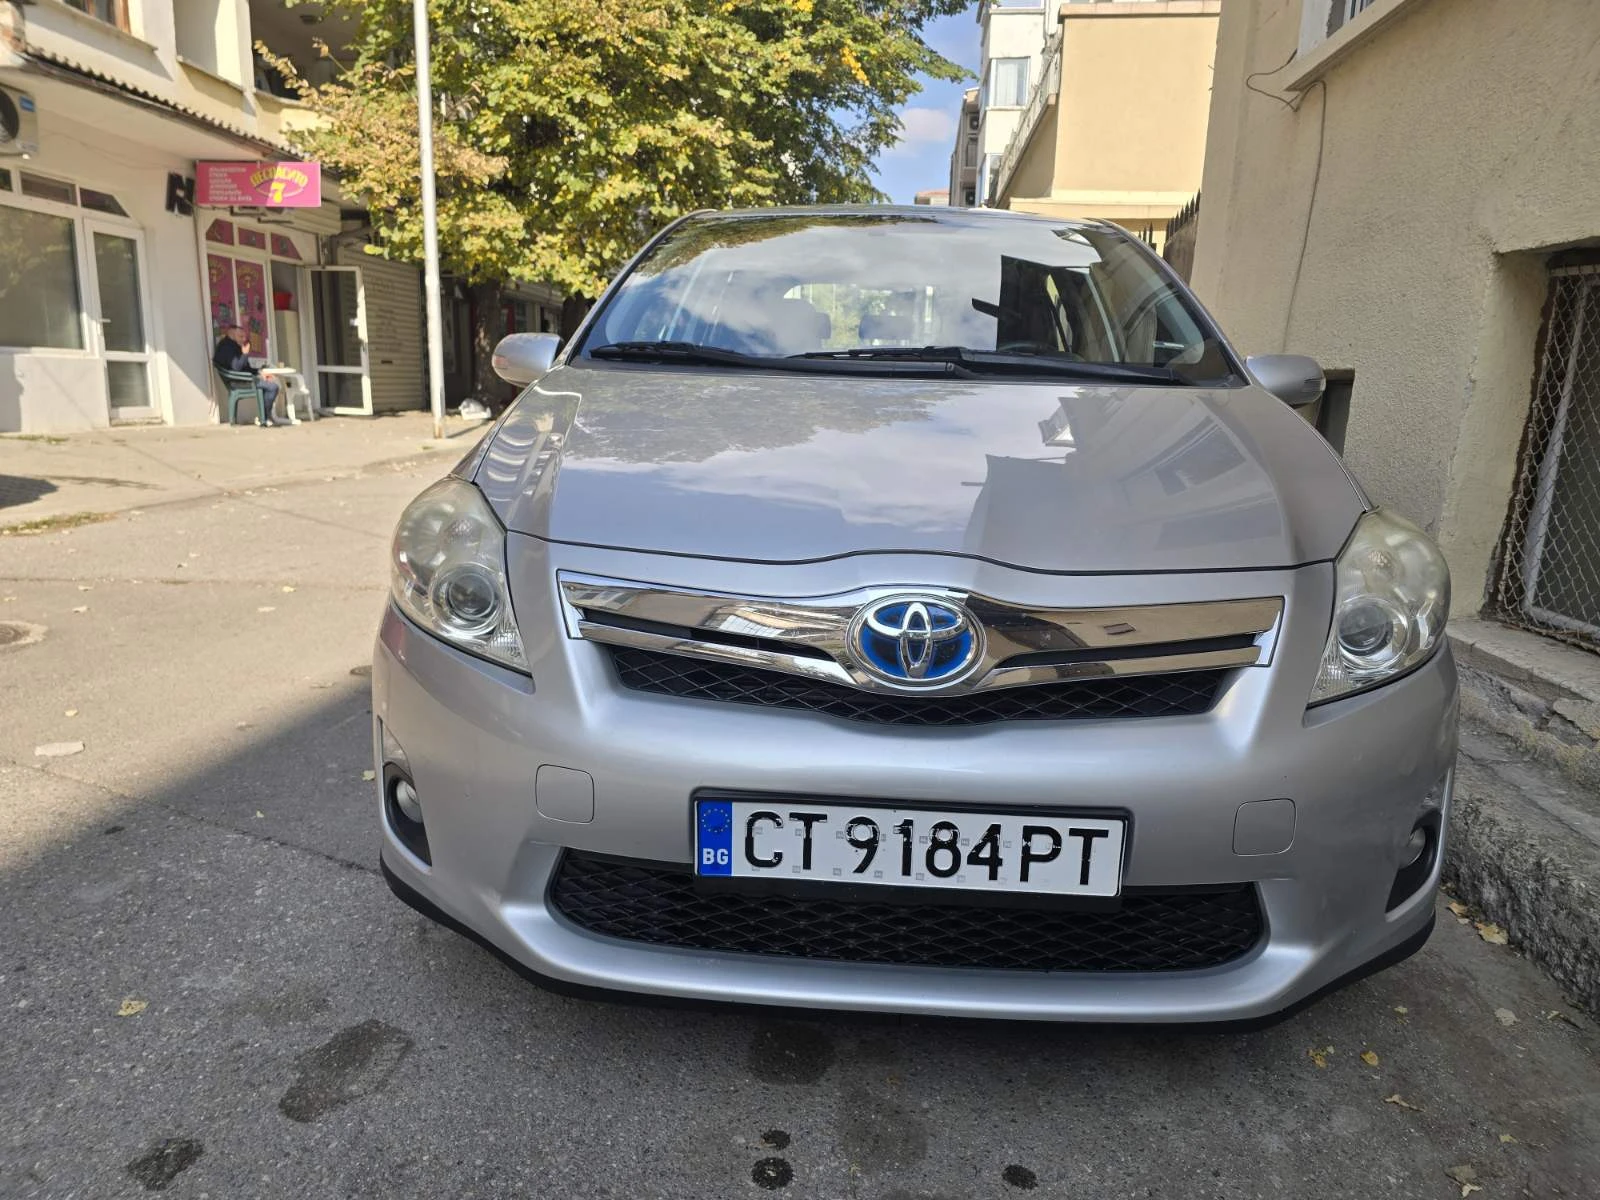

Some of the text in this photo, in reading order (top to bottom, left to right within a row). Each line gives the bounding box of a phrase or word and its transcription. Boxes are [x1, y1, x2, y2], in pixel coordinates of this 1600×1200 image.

[271, 181, 286, 204] 7
[702, 848, 729, 865] BG
[744, 810, 1109, 885] CT 9184 PT
